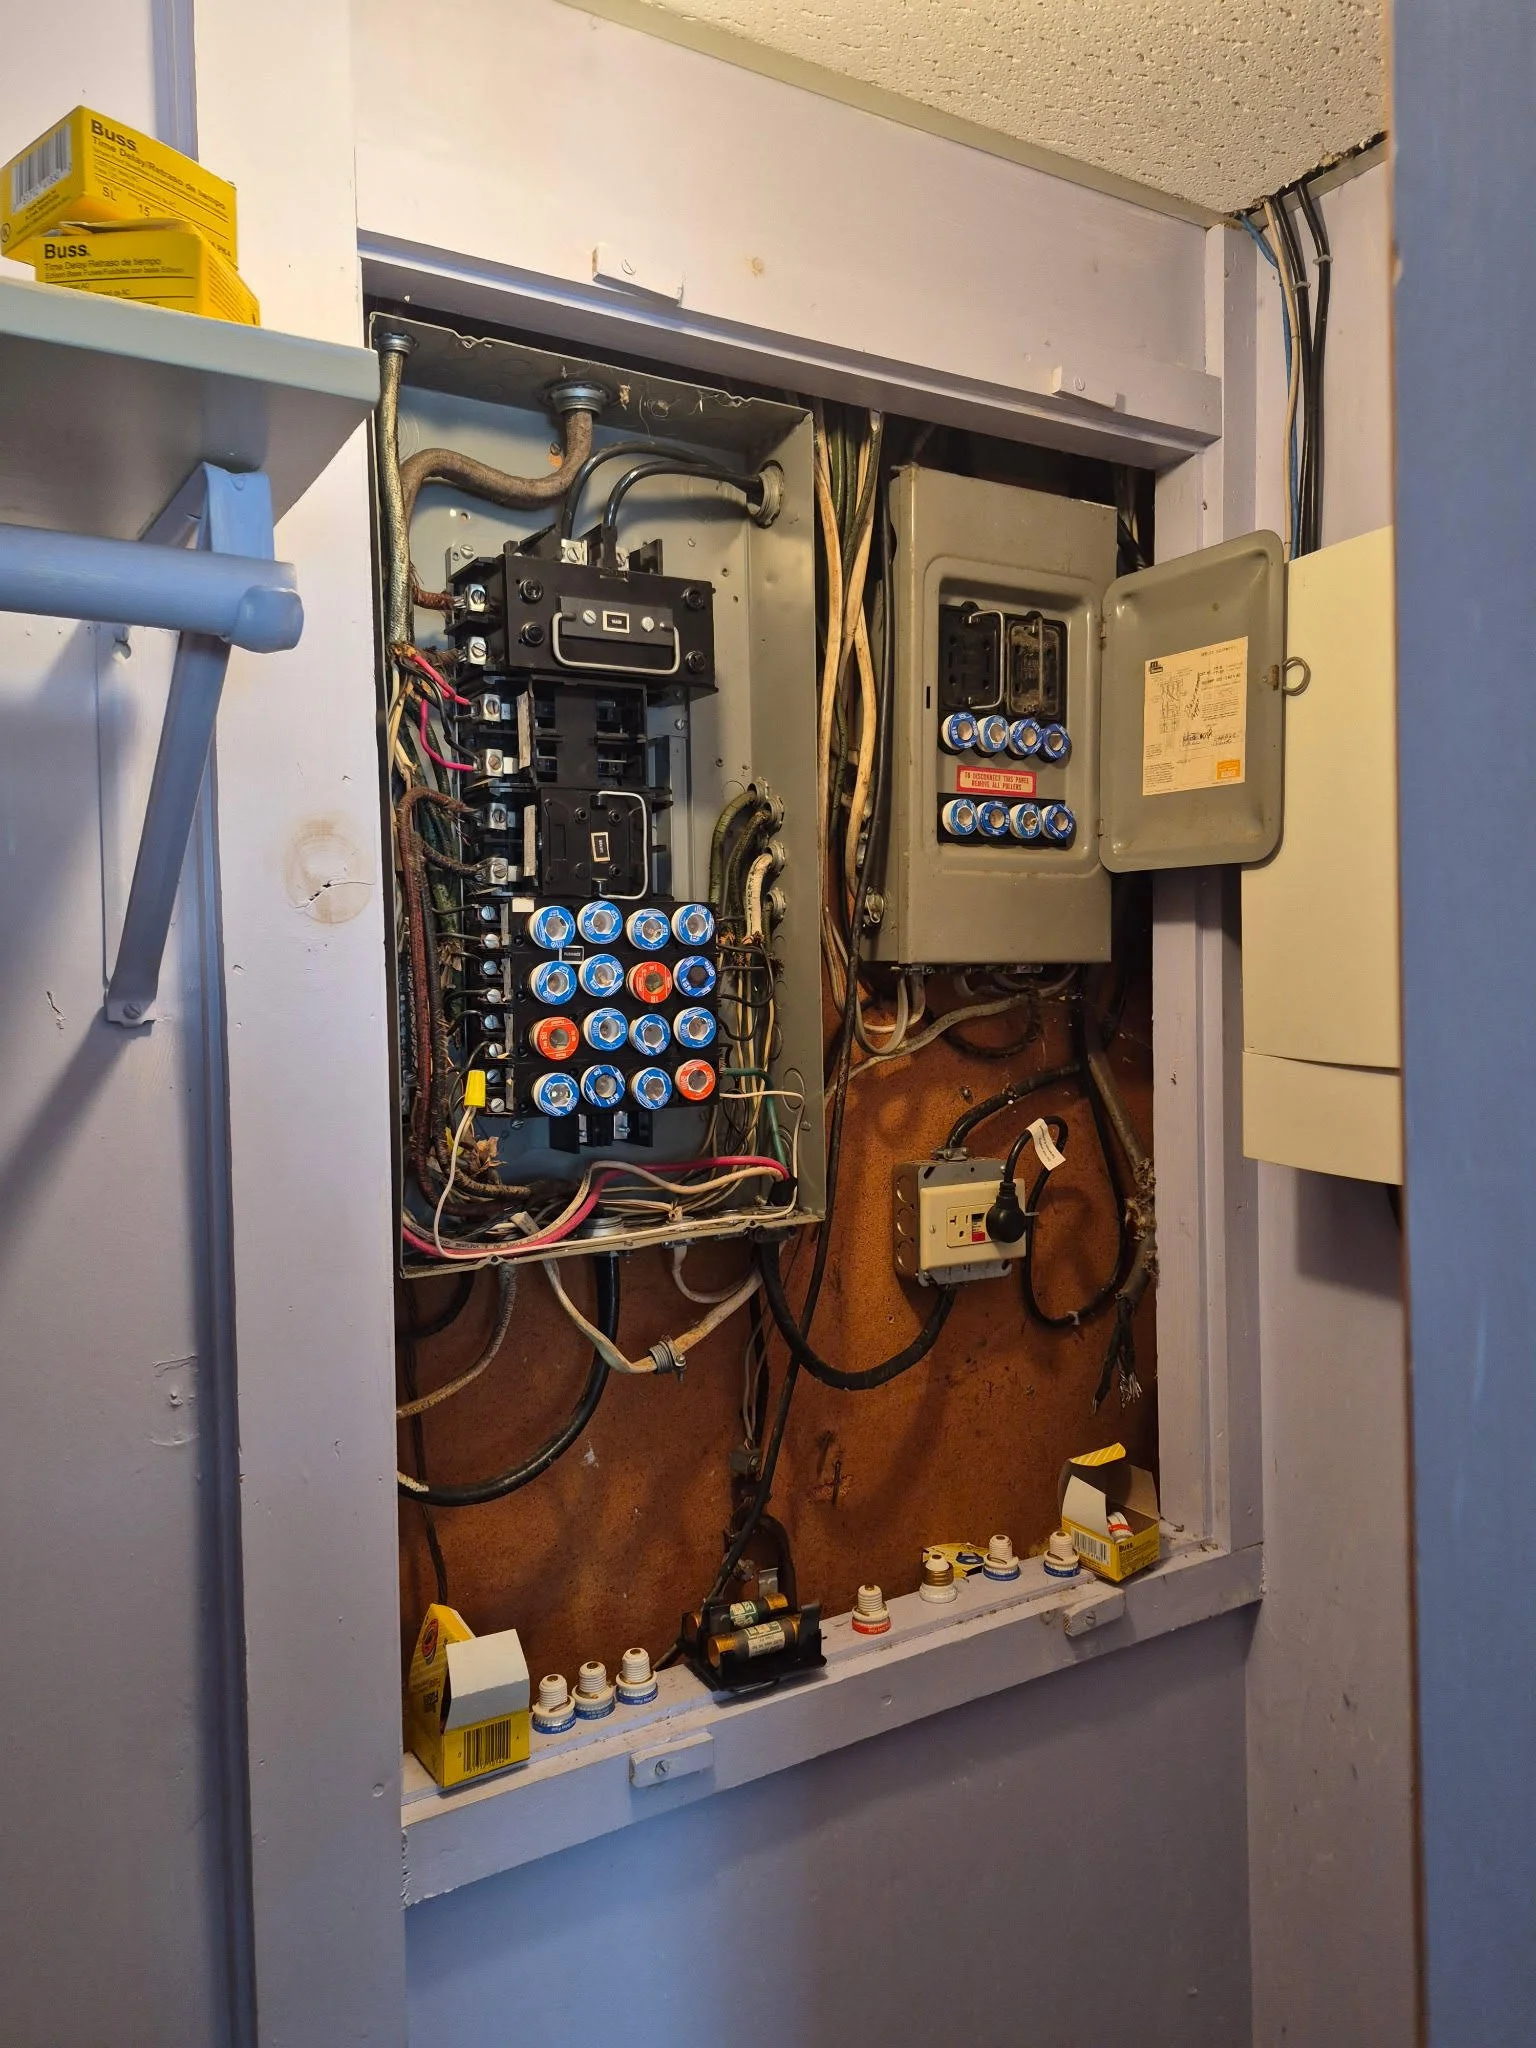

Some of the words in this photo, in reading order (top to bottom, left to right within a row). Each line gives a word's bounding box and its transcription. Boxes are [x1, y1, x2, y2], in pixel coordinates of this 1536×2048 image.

[91, 119, 137, 152] Buss
[92, 135, 117, 152] Time
[102, 186, 117, 202] SL
[139, 203, 150, 217] 15
[44, 243, 88, 259] Buss
[44, 262, 64, 271] Time
[971, 779, 990, 789] REMOVE
[992, 781, 1001, 789] ALL
[1002, 782, 1022, 791] PULLERS
[972, 772, 1001, 782] DISCONNECT
[1003, 775, 1014, 783] THIS
[1015, 776, 1029, 785] PANEL
